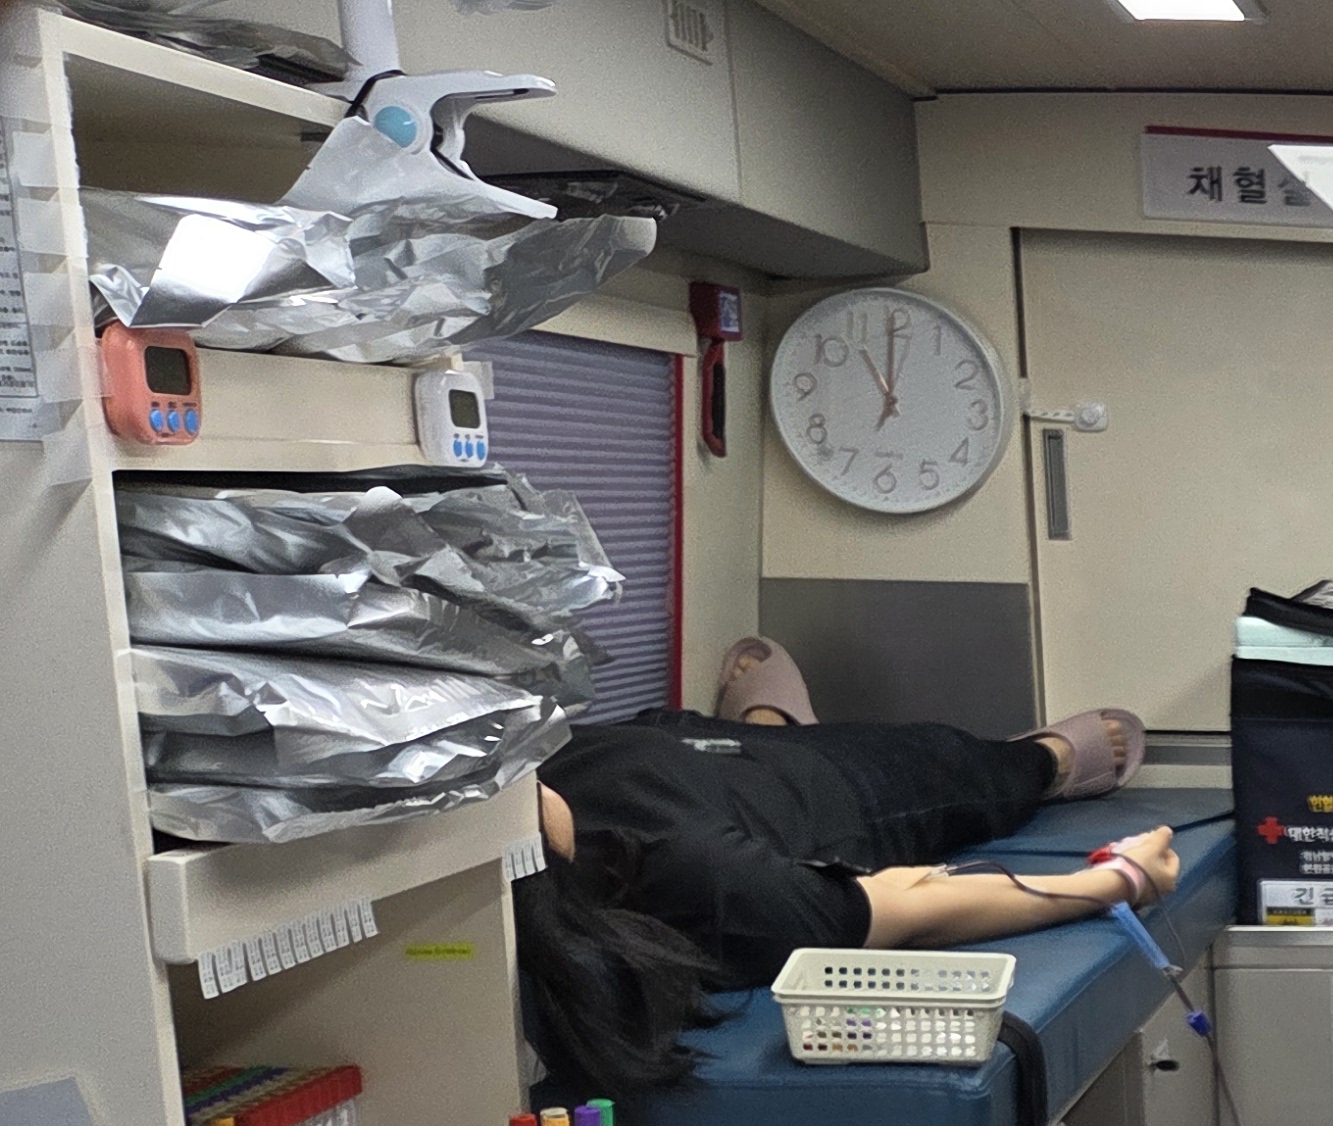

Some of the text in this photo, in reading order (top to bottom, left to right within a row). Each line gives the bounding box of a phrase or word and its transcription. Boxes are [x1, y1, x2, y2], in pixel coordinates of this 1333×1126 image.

[814, 333, 850, 368] 10
[932, 324, 942, 356] 1
[793, 371, 818, 402] 9
[954, 359, 980, 391] 2
[806, 413, 828, 445] 8
[967, 398, 989, 432] 3
[837, 448, 860, 476] 7
[949, 437, 970, 466] 4
[873, 463, 897, 494] 6
[919, 459, 940, 491] 5
